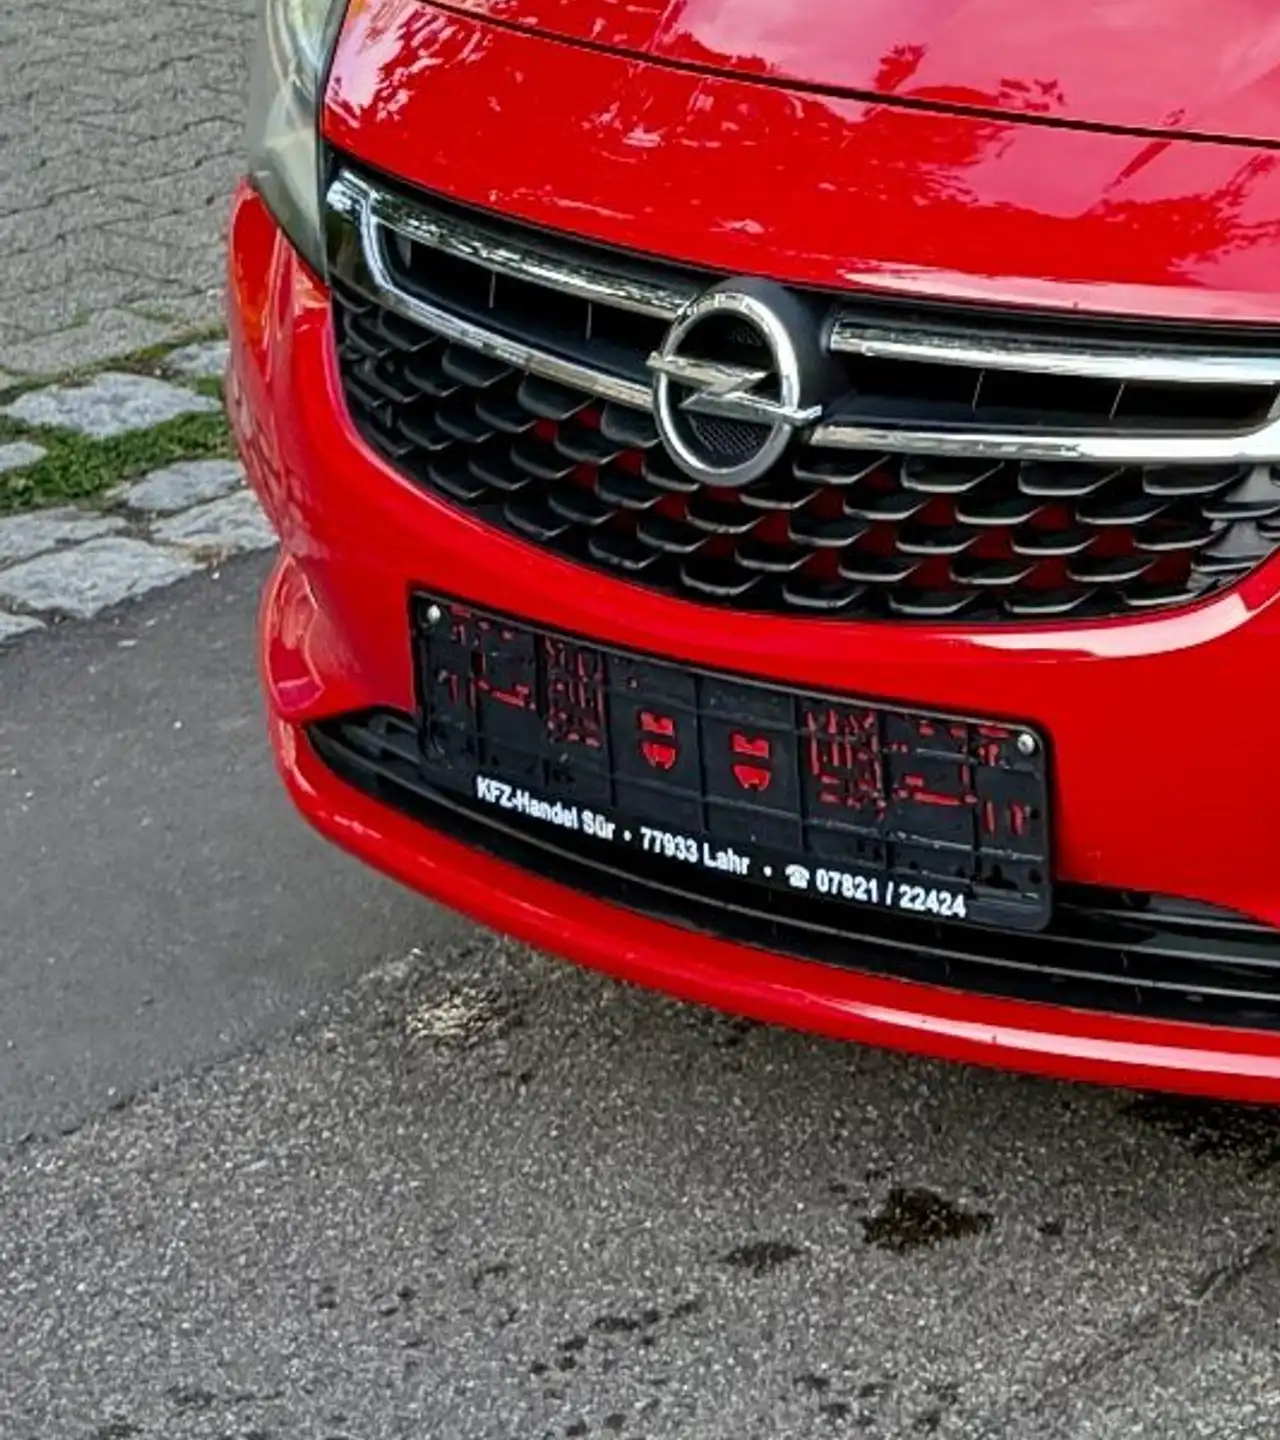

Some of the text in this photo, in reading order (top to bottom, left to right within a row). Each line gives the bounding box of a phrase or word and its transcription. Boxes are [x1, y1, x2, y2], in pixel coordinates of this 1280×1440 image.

[476, 774, 579, 829] KFZ-Handel
[640, 826, 699, 863] 77933
[703, 841, 750, 875] Lahr
[815, 868, 879, 904] 07821
[899, 883, 967, 918] 22424
